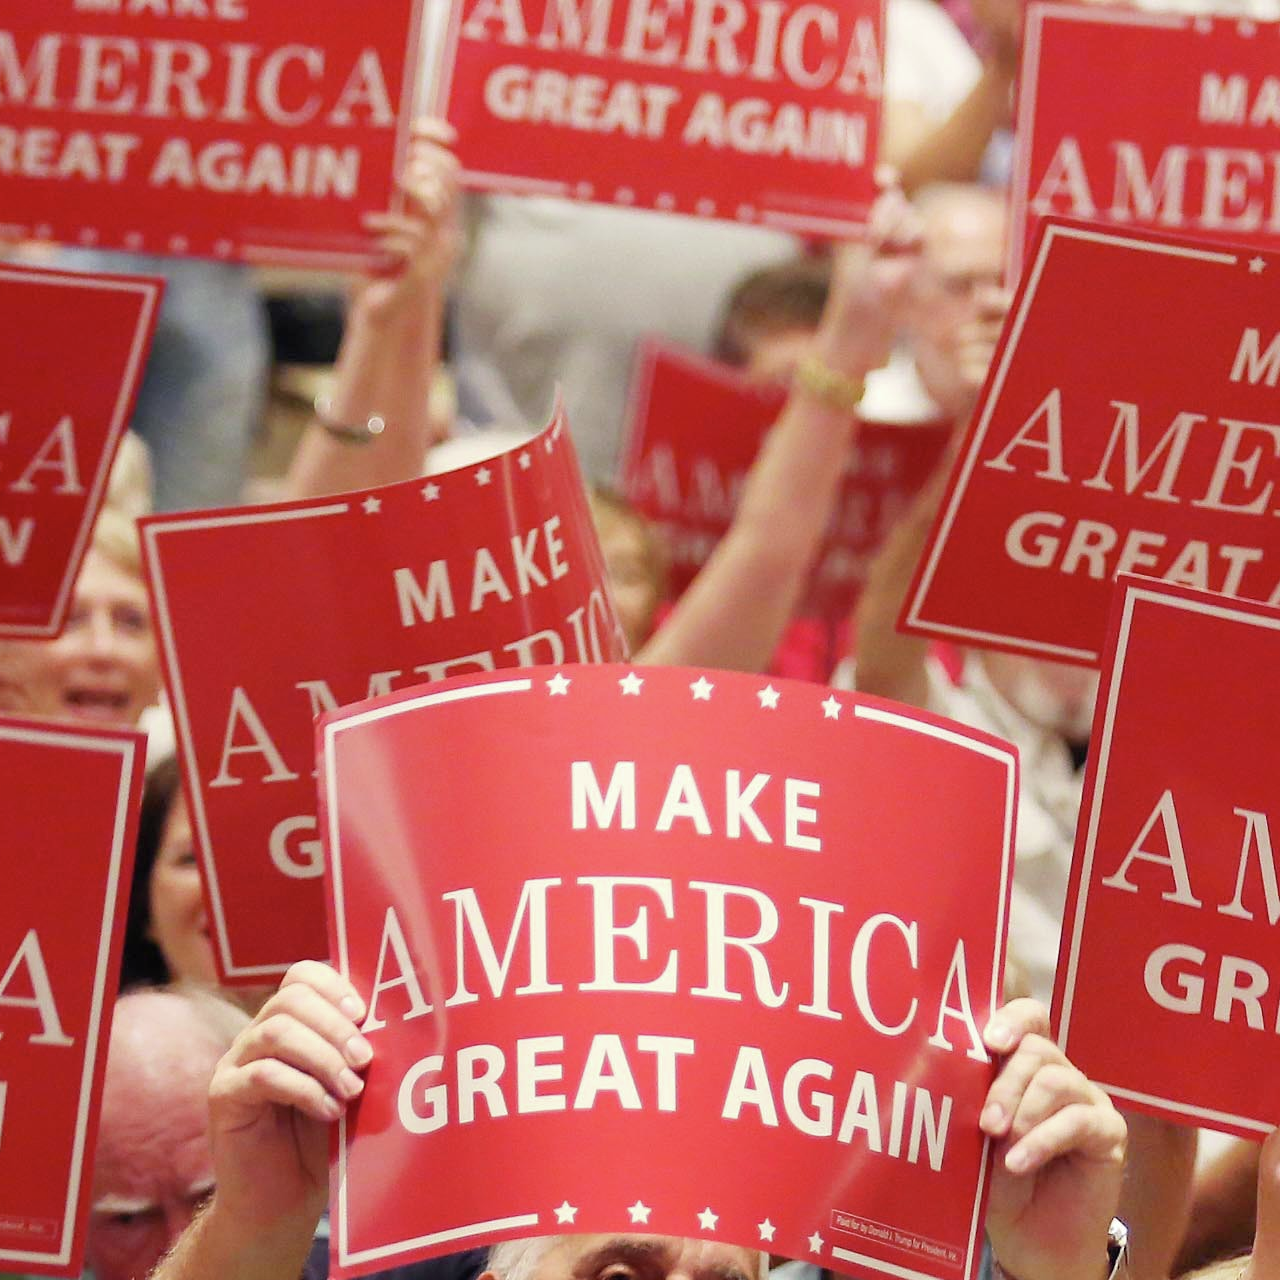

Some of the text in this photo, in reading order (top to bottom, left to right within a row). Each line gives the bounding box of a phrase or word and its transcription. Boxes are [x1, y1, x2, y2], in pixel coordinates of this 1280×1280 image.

[150, 137, 360, 197] AGAIN
[484, 64, 869, 167] GREAT AGAIN
[393, 515, 570, 628] MAKE
[1004, 510, 1263, 599] GREAT
[571, 761, 822, 852] MAKE
[361, 875, 992, 1064] AMERICA
[397, 1033, 954, 1173] GREAT AGAIN
